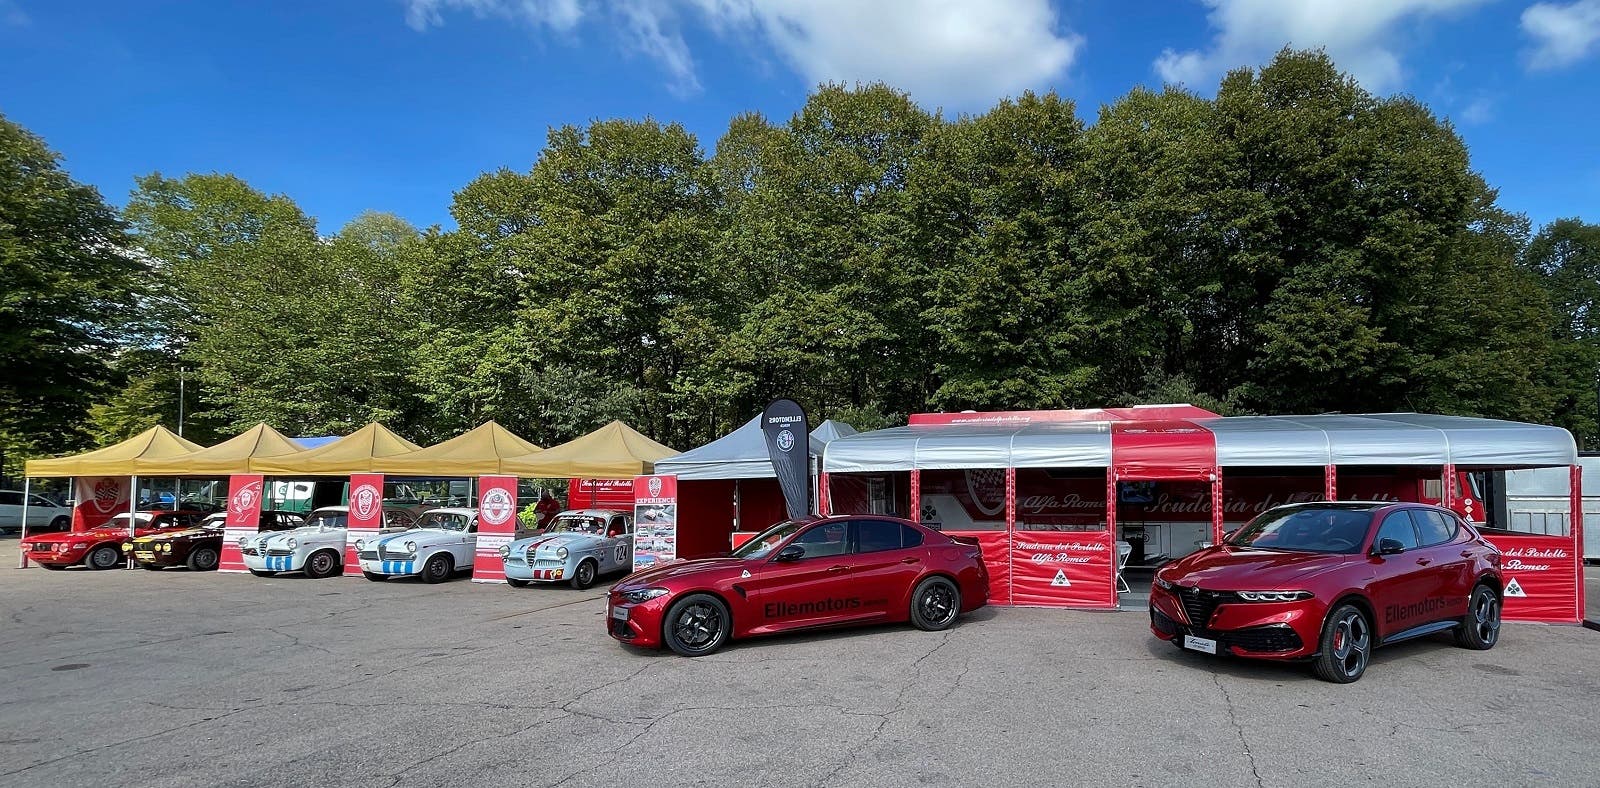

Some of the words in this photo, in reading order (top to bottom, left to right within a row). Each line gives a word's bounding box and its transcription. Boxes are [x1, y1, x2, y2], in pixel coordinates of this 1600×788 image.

[1023, 495, 1060, 514] Alfa
[1061, 493, 1107, 509] Rome
[1143, 492, 1251, 513] Scudeia
[1016, 541, 1053, 551] Scuderia
[1054, 542, 1069, 551] del
[1070, 541, 1105, 552] Portello
[1504, 547, 1524, 557] del
[1524, 547, 1568, 558] Portello
[1031, 552, 1054, 566] Alfa
[1053, 552, 1091, 563] Romeo
[1506, 559, 1550, 571] Romeo
[764, 597, 860, 619] Ellemotors
[1385, 596, 1445, 624] Ellemotors
